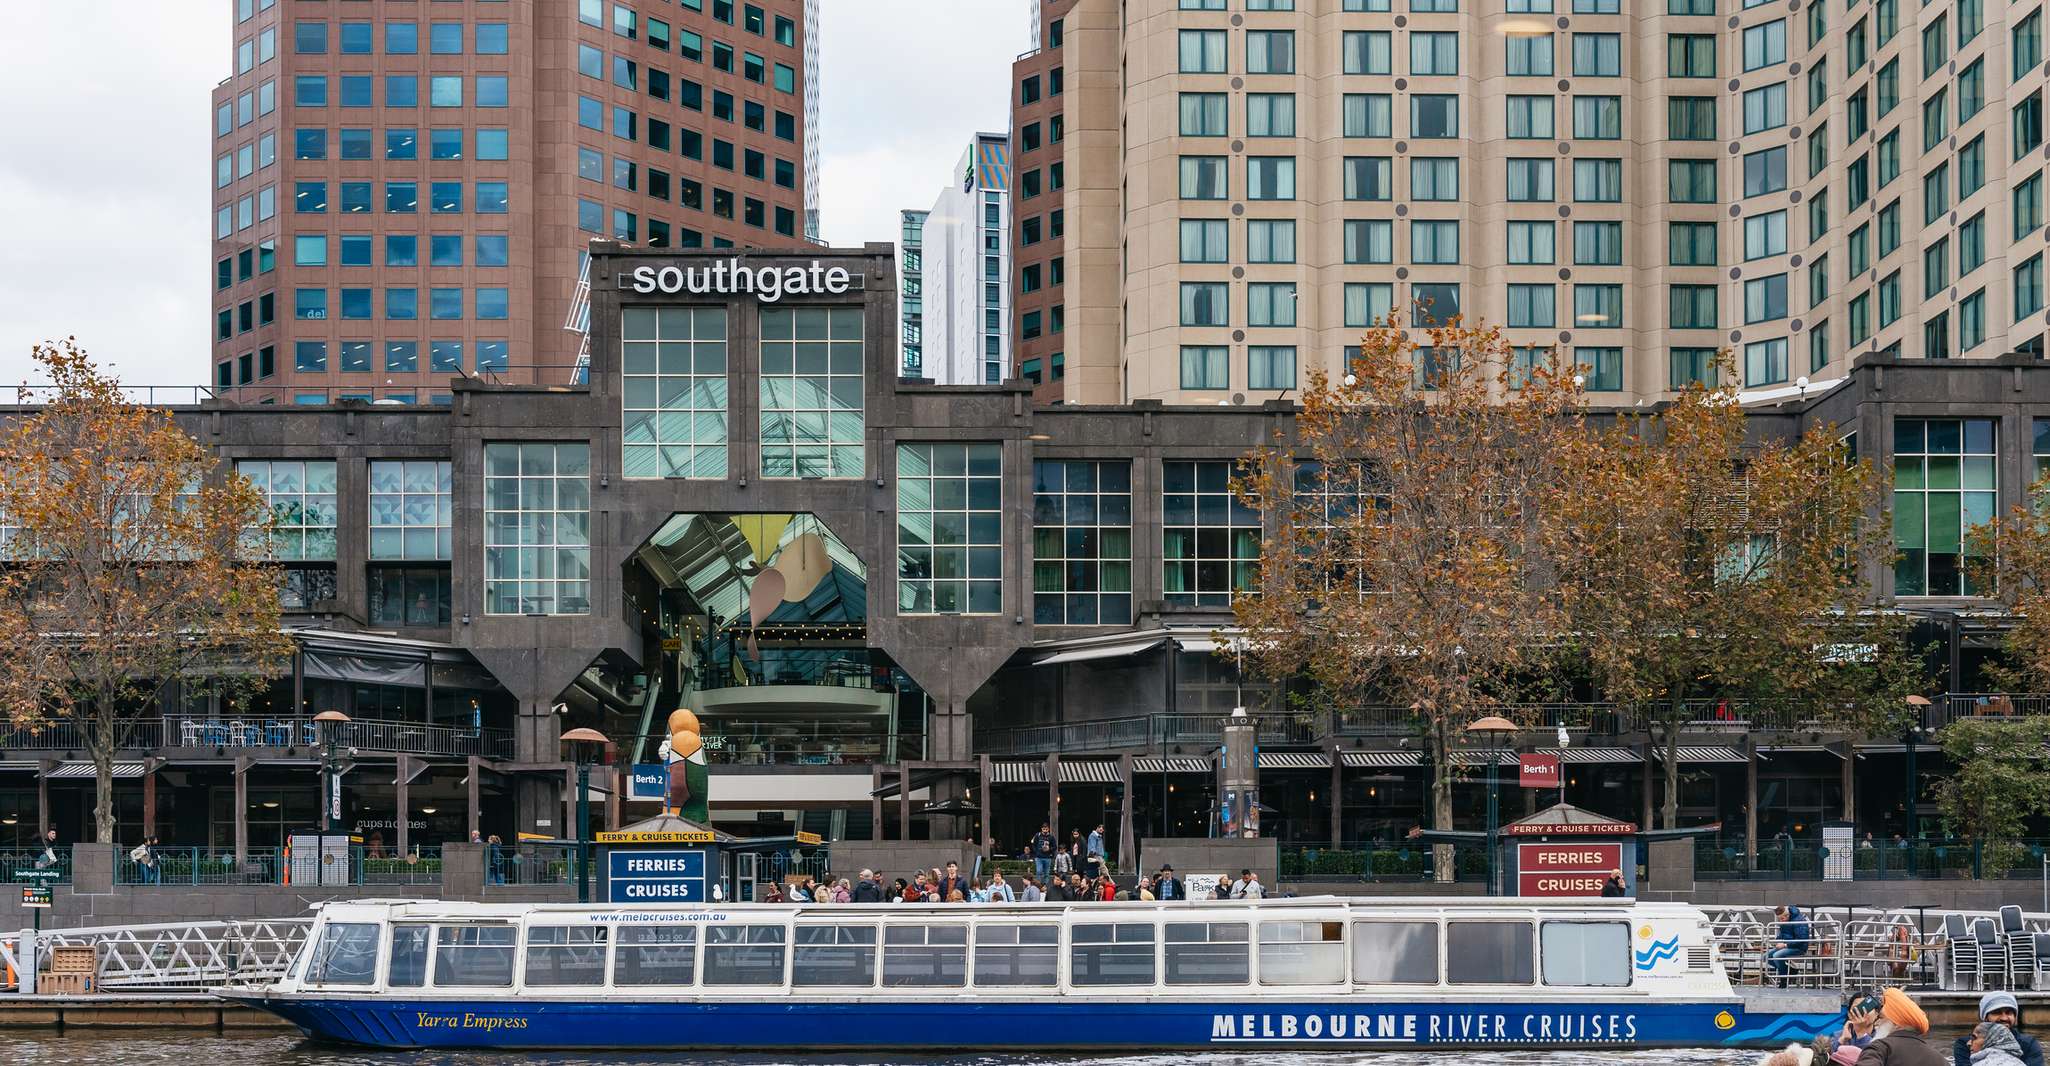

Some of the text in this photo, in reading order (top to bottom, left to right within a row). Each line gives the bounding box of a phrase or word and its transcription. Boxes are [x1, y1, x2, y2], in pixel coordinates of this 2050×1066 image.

[633, 258, 850, 302] southgate
[1523, 764, 1555, 774] Berth 1
[635, 774, 664, 784] Berth 2
[356, 820, 384, 830] cups
[393, 820, 428, 829] cnes
[1513, 824, 1631, 833] FERRY & CRUISE TICKETS
[602, 833, 709, 841] FERRY & CRUISE TICKETS
[1538, 852, 1603, 864] FERRIES
[627, 859, 686, 872] FERRIES
[626, 884, 689, 897] CRUISES
[1537, 879, 1604, 891] CRUISES
[416, 1012, 528, 1032] Yarra Empress
[1211, 1014, 1637, 1038] MELBOURNE RIVER CRUISES
